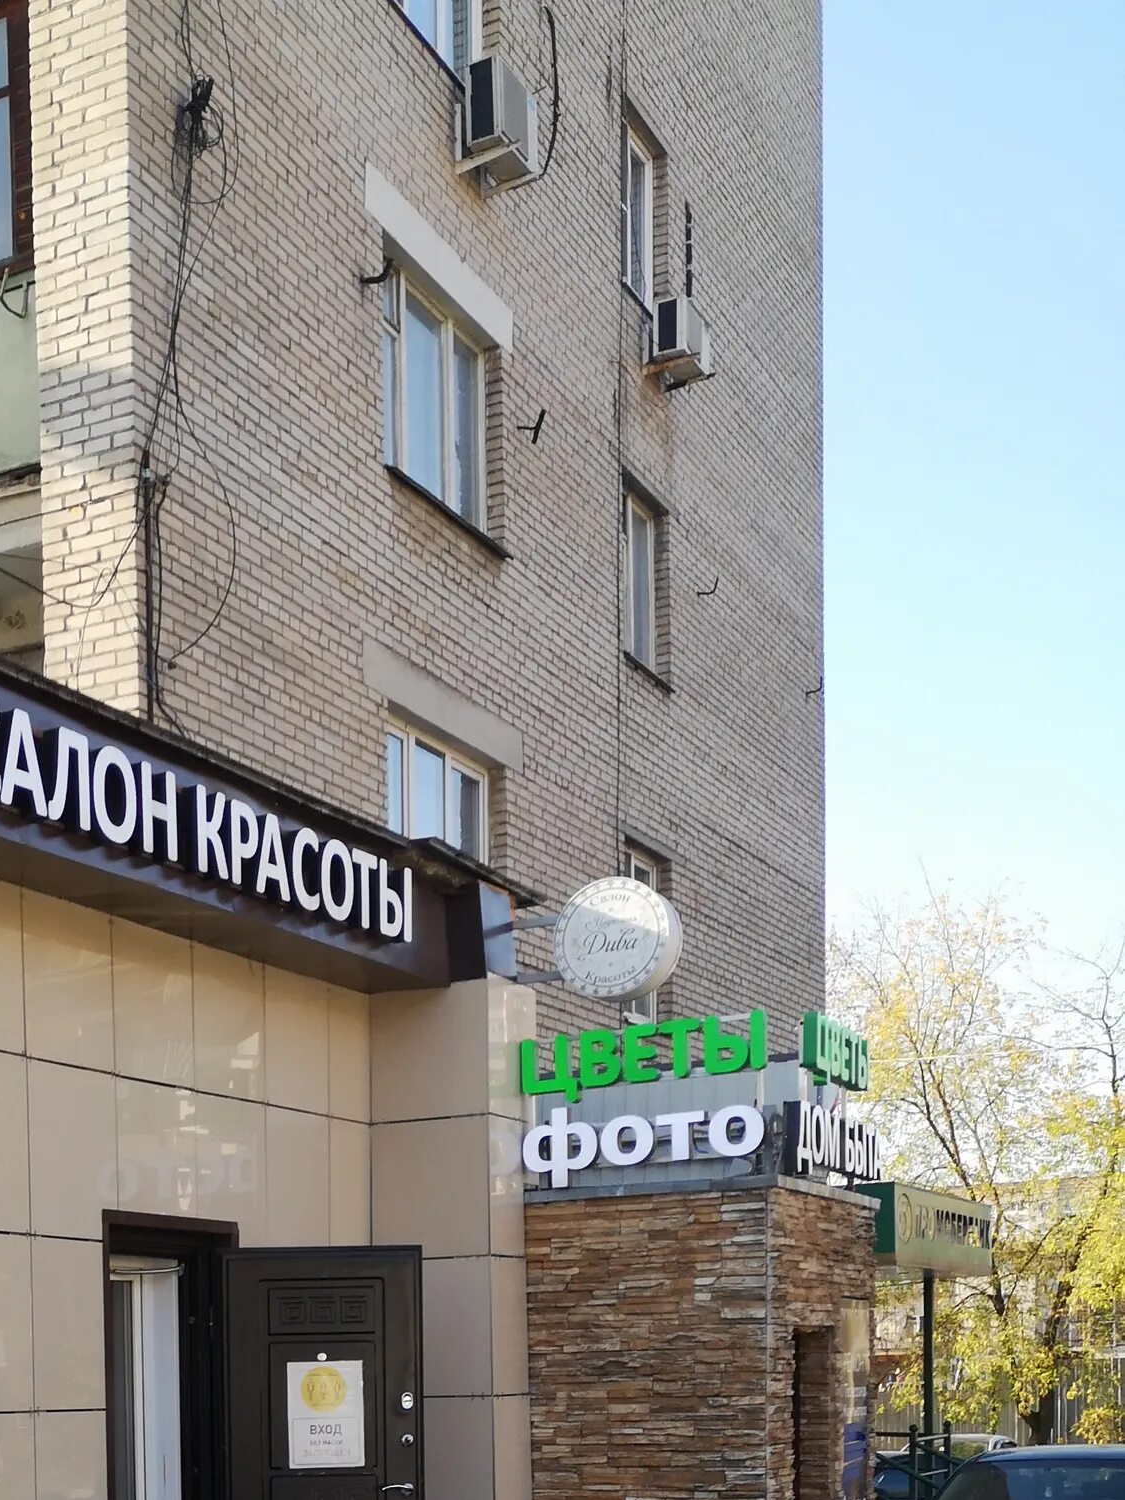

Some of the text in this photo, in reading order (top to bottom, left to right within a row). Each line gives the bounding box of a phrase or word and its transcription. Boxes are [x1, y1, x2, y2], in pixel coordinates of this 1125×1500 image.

[195, 783, 413, 942] КРАСОТЫ
[520, 1008, 767, 1104] ЦВЕТЫ
[815, 1014, 870, 1091] ЦВЕТЫ
[797, 1099, 883, 1181] ДОМ БЫТА
[309, 1424, 343, 1436] ВХОД
